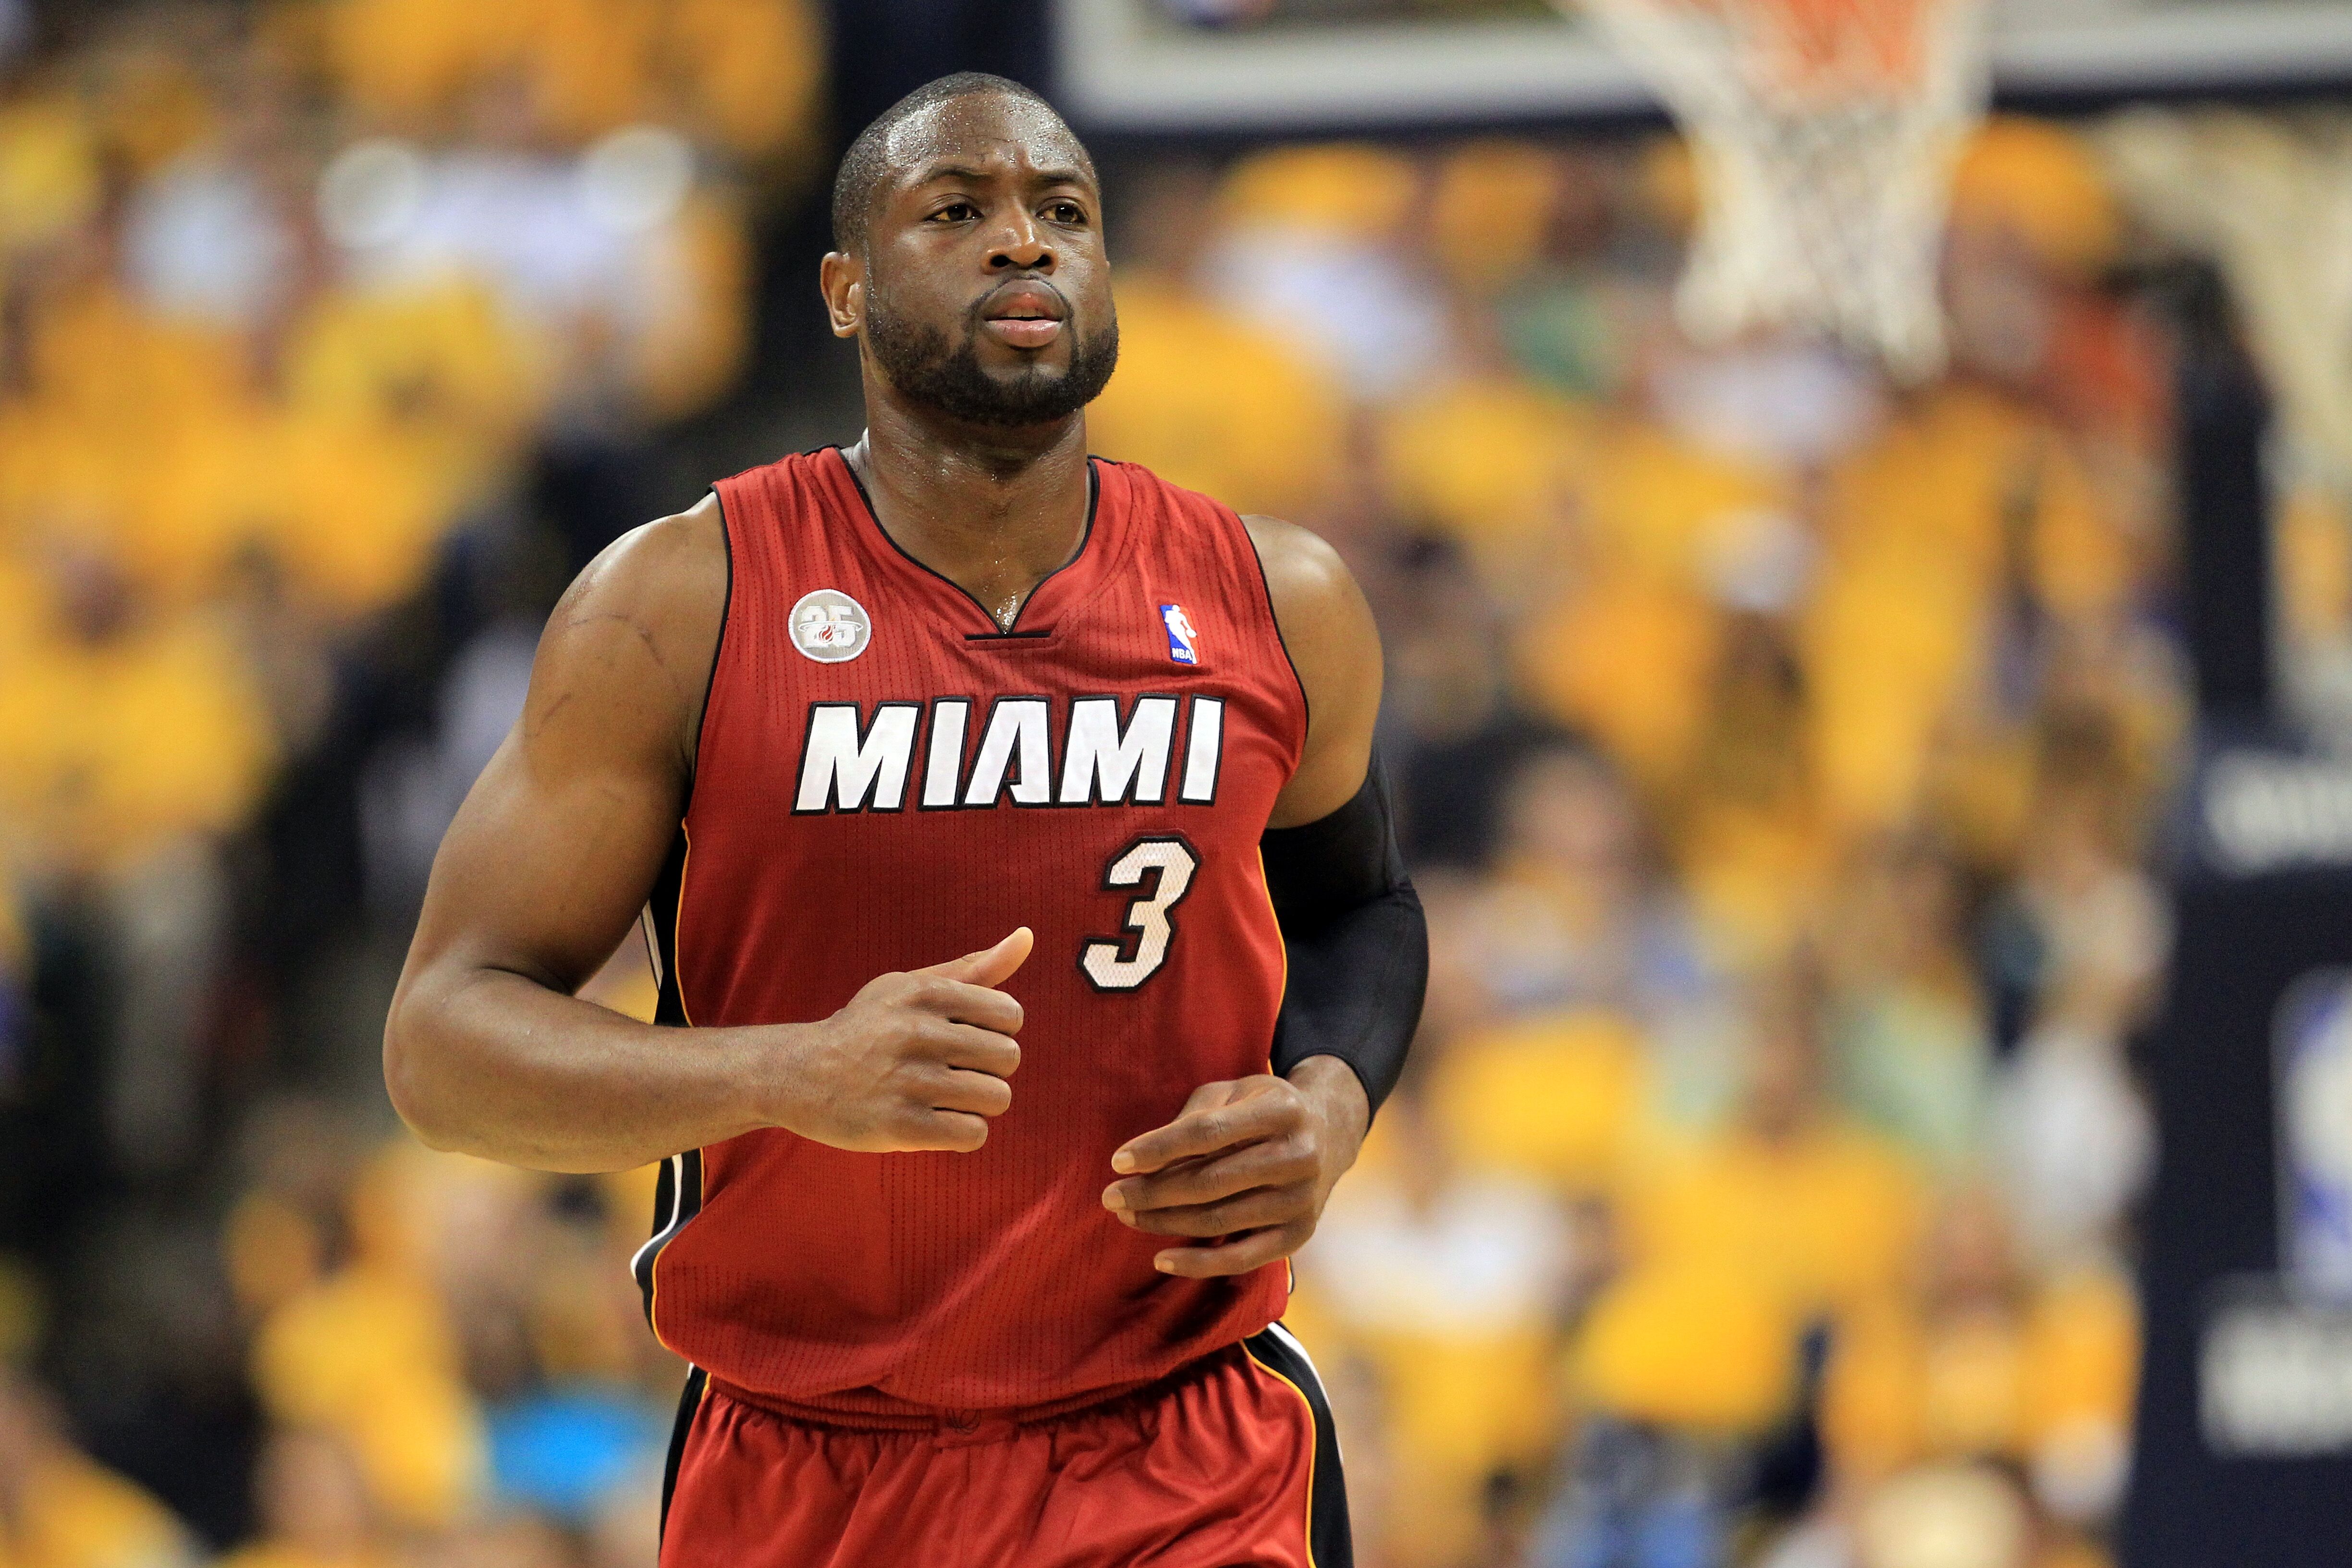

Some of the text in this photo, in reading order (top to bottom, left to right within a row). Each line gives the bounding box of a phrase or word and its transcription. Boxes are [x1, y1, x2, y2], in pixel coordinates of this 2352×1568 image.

[801, 605, 855, 648] 25
[1172, 647, 1192, 661] NBA
[790, 693, 1225, 815] MIAMI
[1078, 835, 1201, 993] 3
